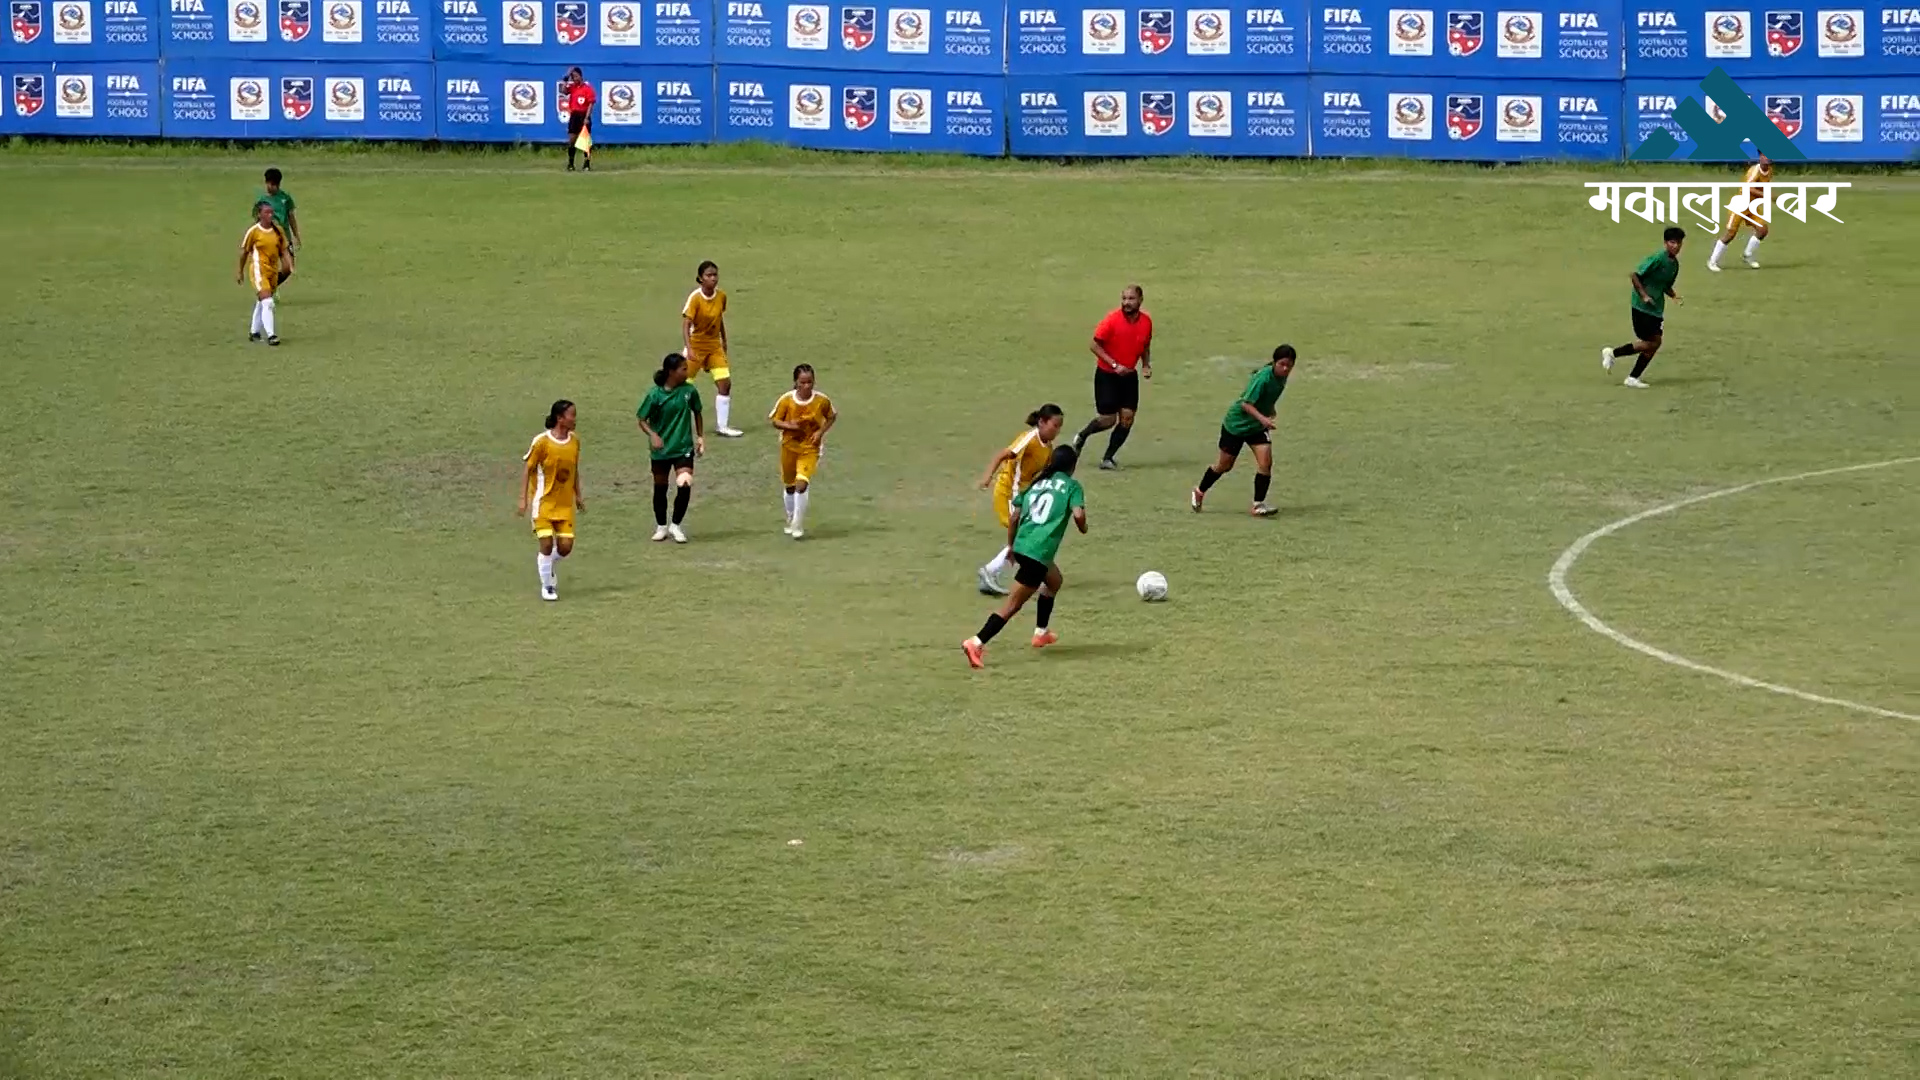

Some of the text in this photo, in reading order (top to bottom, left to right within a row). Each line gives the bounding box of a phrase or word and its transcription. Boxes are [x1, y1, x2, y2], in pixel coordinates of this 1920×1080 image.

[104, 1, 138, 14] FIFA
[170, 0, 205, 11] FIFA
[376, 0, 411, 13] FIFA
[443, 0, 478, 13] FIFA
[655, 3, 692, 16] FIFA
[727, 3, 763, 16] FIFA
[945, 11, 982, 24] FIFA
[1019, 10, 1057, 23] FIFA
[1246, 10, 1285, 23] FIFA
[1323, 9, 1362, 23] FIFA
[1559, 13, 1599, 27] FIFA
[1637, 12, 1677, 26] FIFA
[1881, 9, 1920, 24] FIFA
[105, 32, 148, 42] SCHOOLS
[172, 30, 214, 40] SCHOOLS
[377, 33, 420, 43] SCHOOLS
[444, 33, 488, 43] SCHOOLS
[656, 36, 700, 46] SCHOOLS
[727, 36, 771, 46] SCHOOLS
[945, 45, 991, 55] SCHOOLS
[1020, 44, 1067, 54] SCHOOLS
[1246, 44, 1294, 54] SCHOOLS
[1323, 43, 1372, 54] SCHOOLS
[1559, 49, 1608, 59] SCHOOLS
[1638, 47, 1688, 58] SCHOOLS
[106, 76, 140, 89] FIFA
[172, 78, 207, 91] FIFA
[377, 79, 413, 91] FIFA
[446, 80, 481, 93] FIFA
[656, 82, 692, 95] FIFA
[729, 83, 765, 96] FIFA
[946, 91, 983, 105] FIFA
[1020, 93, 1058, 106] FIFA
[1247, 92, 1285, 106] FIFA
[1323, 93, 1362, 106] FIFA
[1637, 95, 1677, 110] FIFA
[1880, 95, 1920, 109] FIFA
[1558, 97, 1598, 112] FIFA
[107, 108, 148, 118] SCHOOLS
[173, 110, 216, 120] SCHOOLS
[379, 111, 422, 121] SCHOOLS
[447, 112, 489, 122] SCHOOLS
[657, 115, 702, 125] SCHOOLS
[729, 116, 774, 126] SCHOOLS
[946, 125, 992, 135] SCHOOLS
[1022, 126, 1068, 136] SCHOOLS
[1248, 126, 1295, 136] SCHOOLS
[1323, 127, 1371, 138] SCHOOLS
[1558, 133, 1608, 143] SCHOOLS
